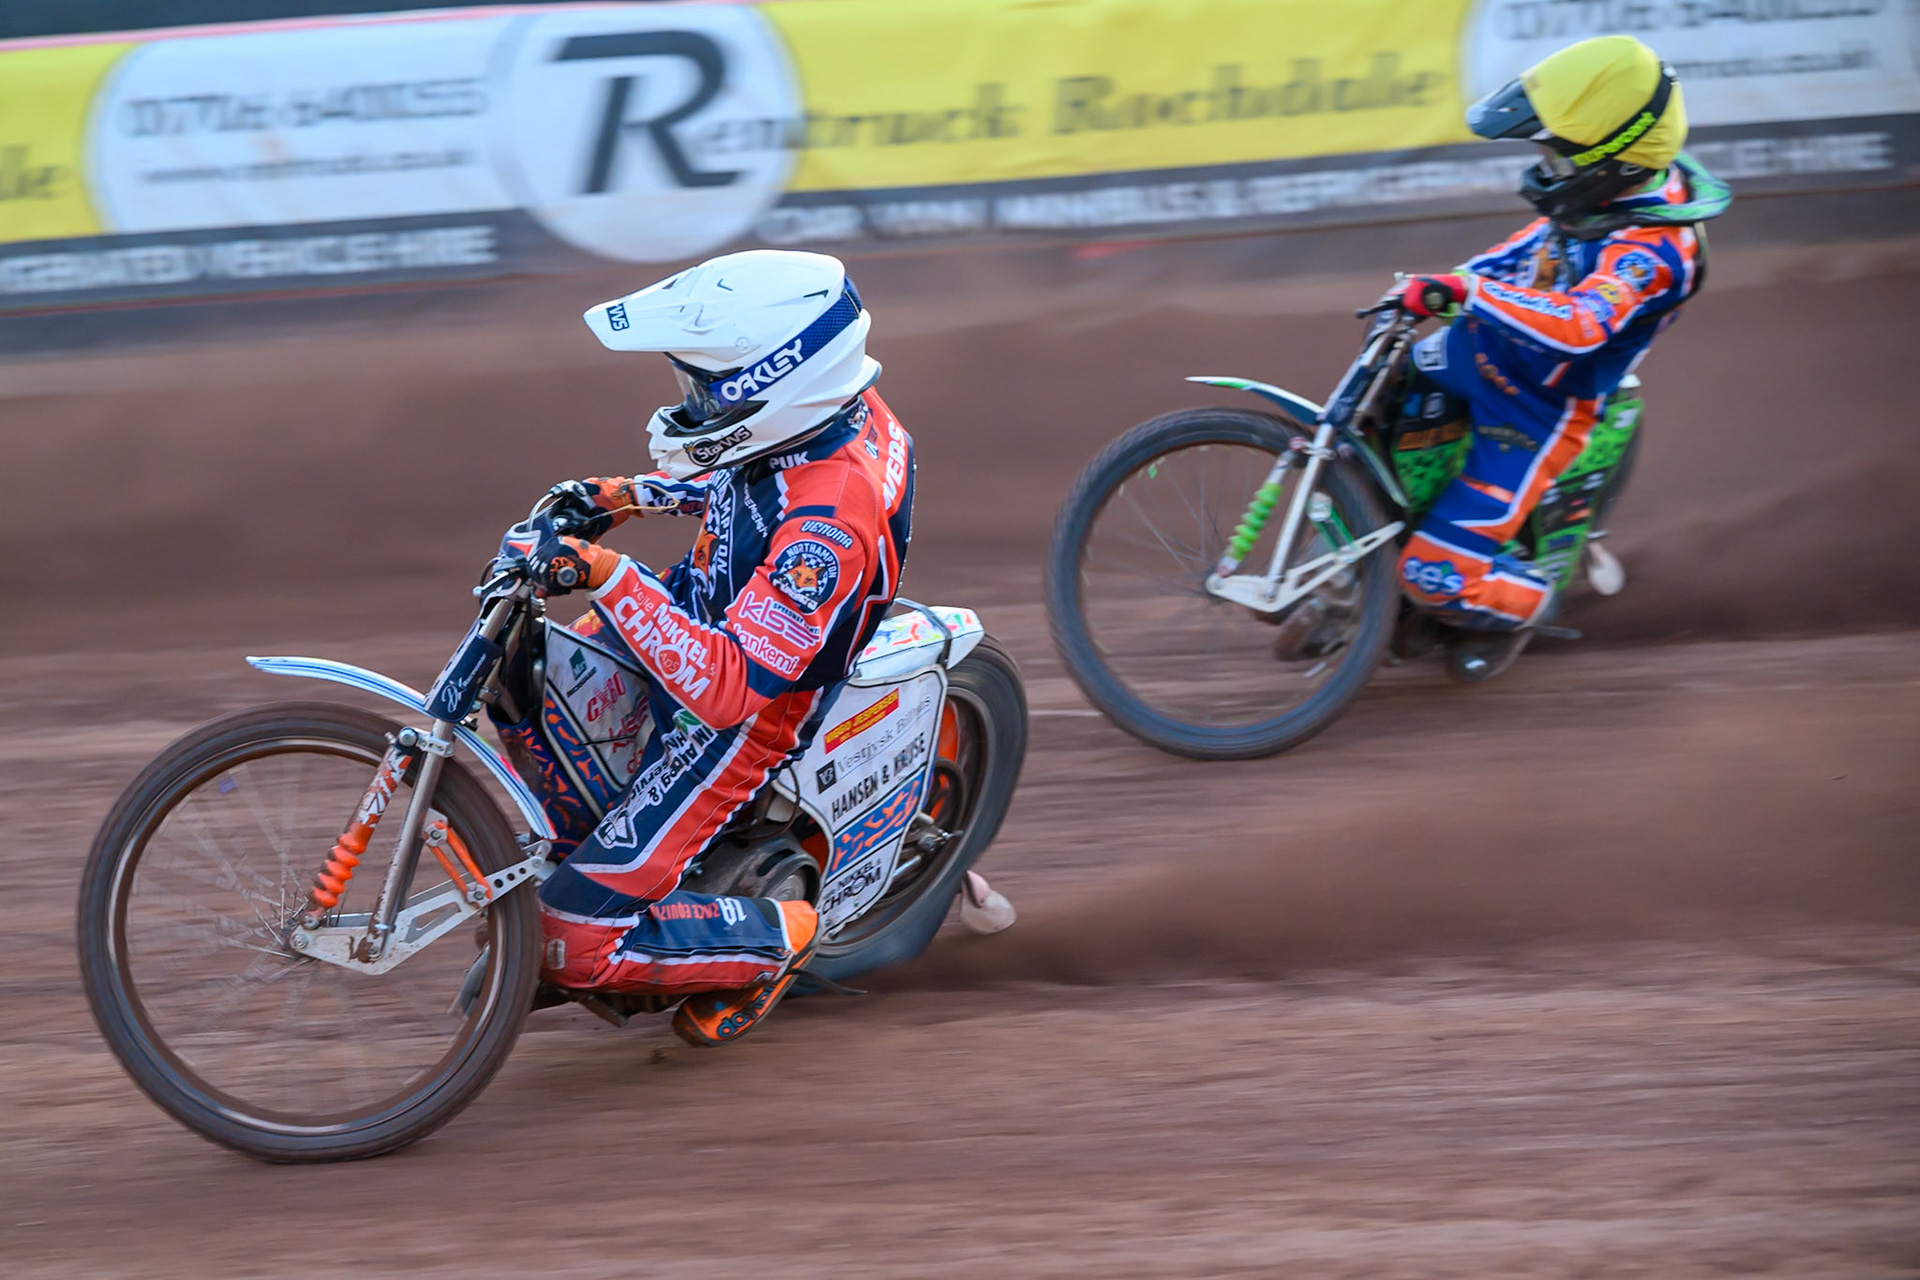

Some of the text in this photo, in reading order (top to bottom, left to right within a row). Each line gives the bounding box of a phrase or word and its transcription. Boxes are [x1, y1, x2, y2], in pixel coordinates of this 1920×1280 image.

[721, 338, 803, 401] OAKLEY
[786, 543, 837, 578] NORTHAMPTON
[633, 582, 654, 612] Vejle
[614, 595, 711, 701] CHROM
[653, 602, 708, 670] NIKKEL
[832, 771, 878, 823] HANSEN
[823, 866, 882, 915] CHROM
